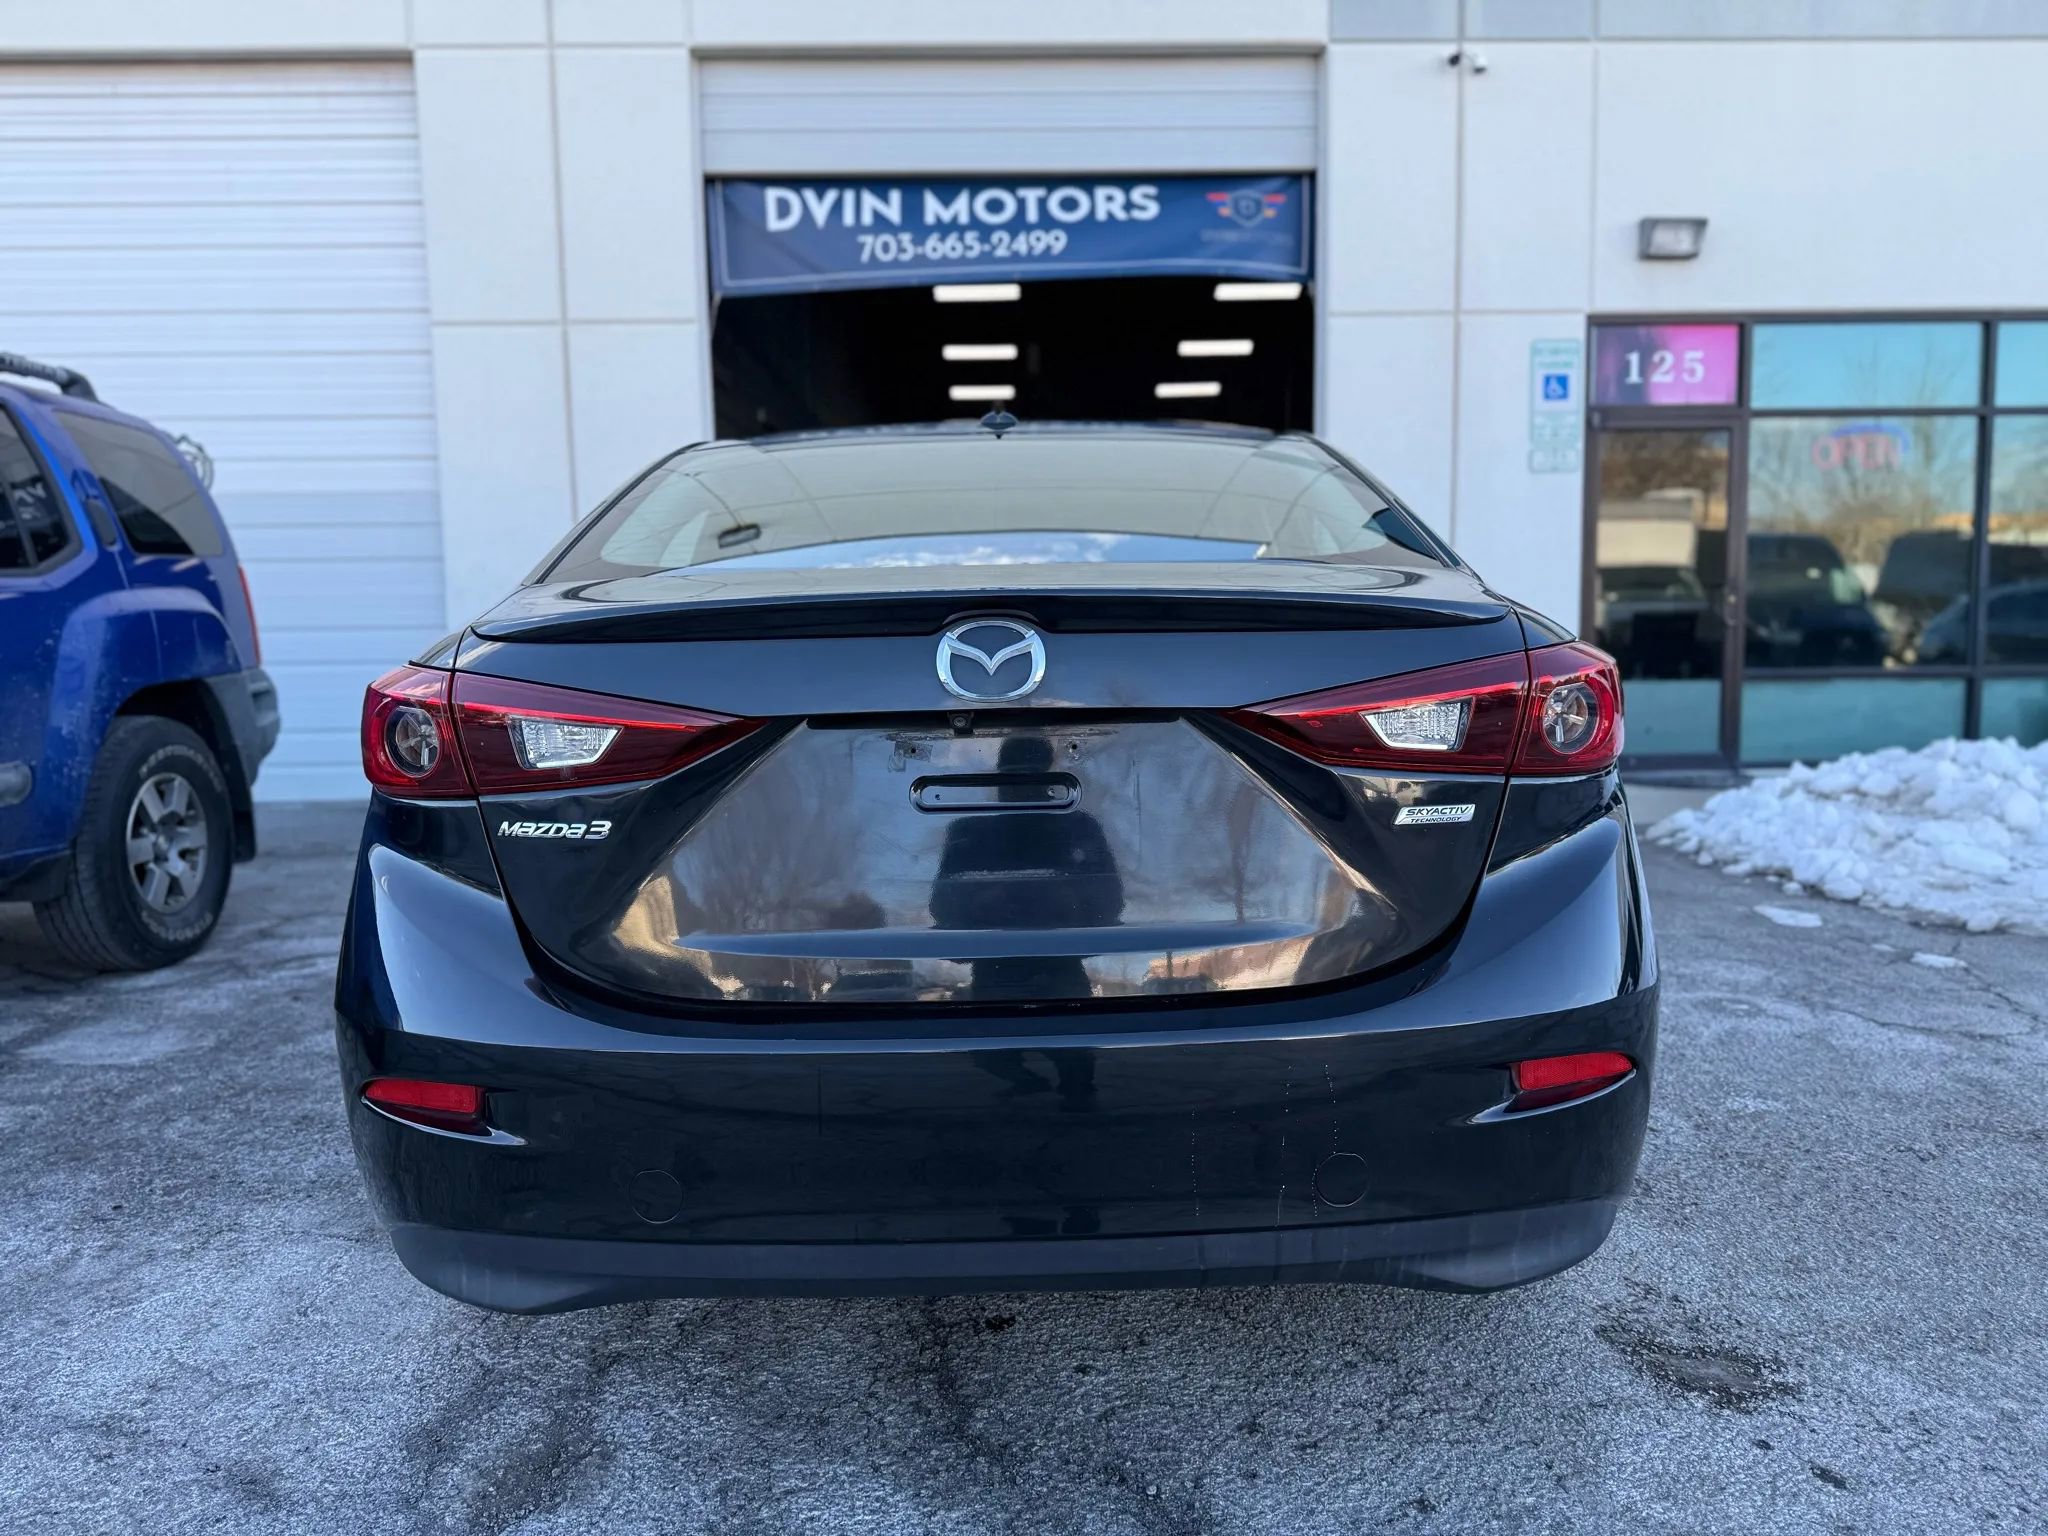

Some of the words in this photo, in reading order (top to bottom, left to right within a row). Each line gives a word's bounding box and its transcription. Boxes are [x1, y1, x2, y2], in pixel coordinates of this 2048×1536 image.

[764, 186, 900, 232] DVIN
[923, 185, 1161, 225] MOTORS
[858, 230, 1068, 262] 703-665-2499
[1624, 350, 1705, 384] 125
[1811, 434, 1901, 471] OPEN
[1405, 806, 1469, 816] SKYACTIV
[1410, 816, 1462, 824] TECHNOLOGY
